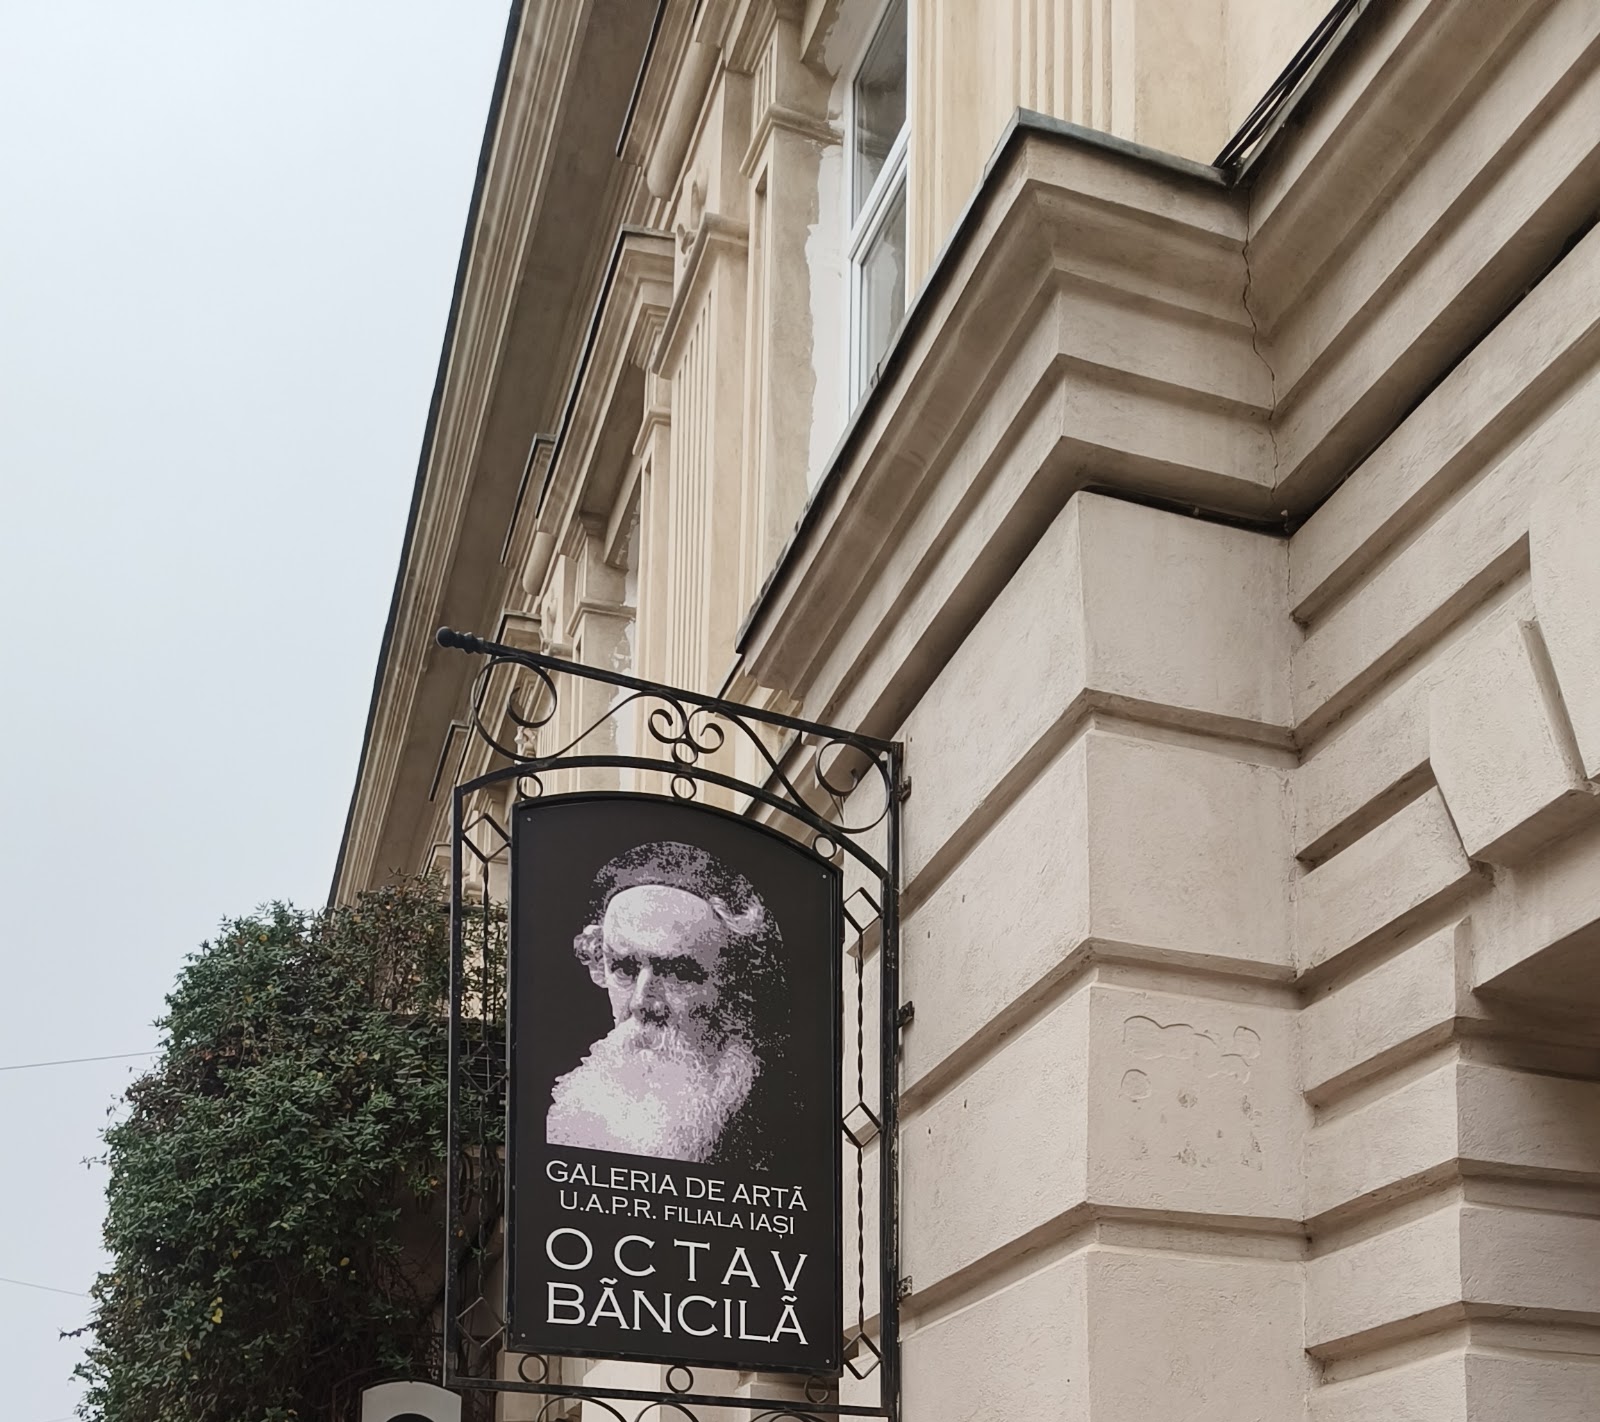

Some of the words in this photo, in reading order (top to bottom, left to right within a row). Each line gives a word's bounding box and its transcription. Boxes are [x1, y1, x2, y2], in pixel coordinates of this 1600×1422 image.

[546, 1160, 678, 1196] GALERIA
[686, 1176, 725, 1202] DE
[559, 1189, 657, 1220] U.A.P.R.
[664, 1205, 744, 1229] FILIALA
